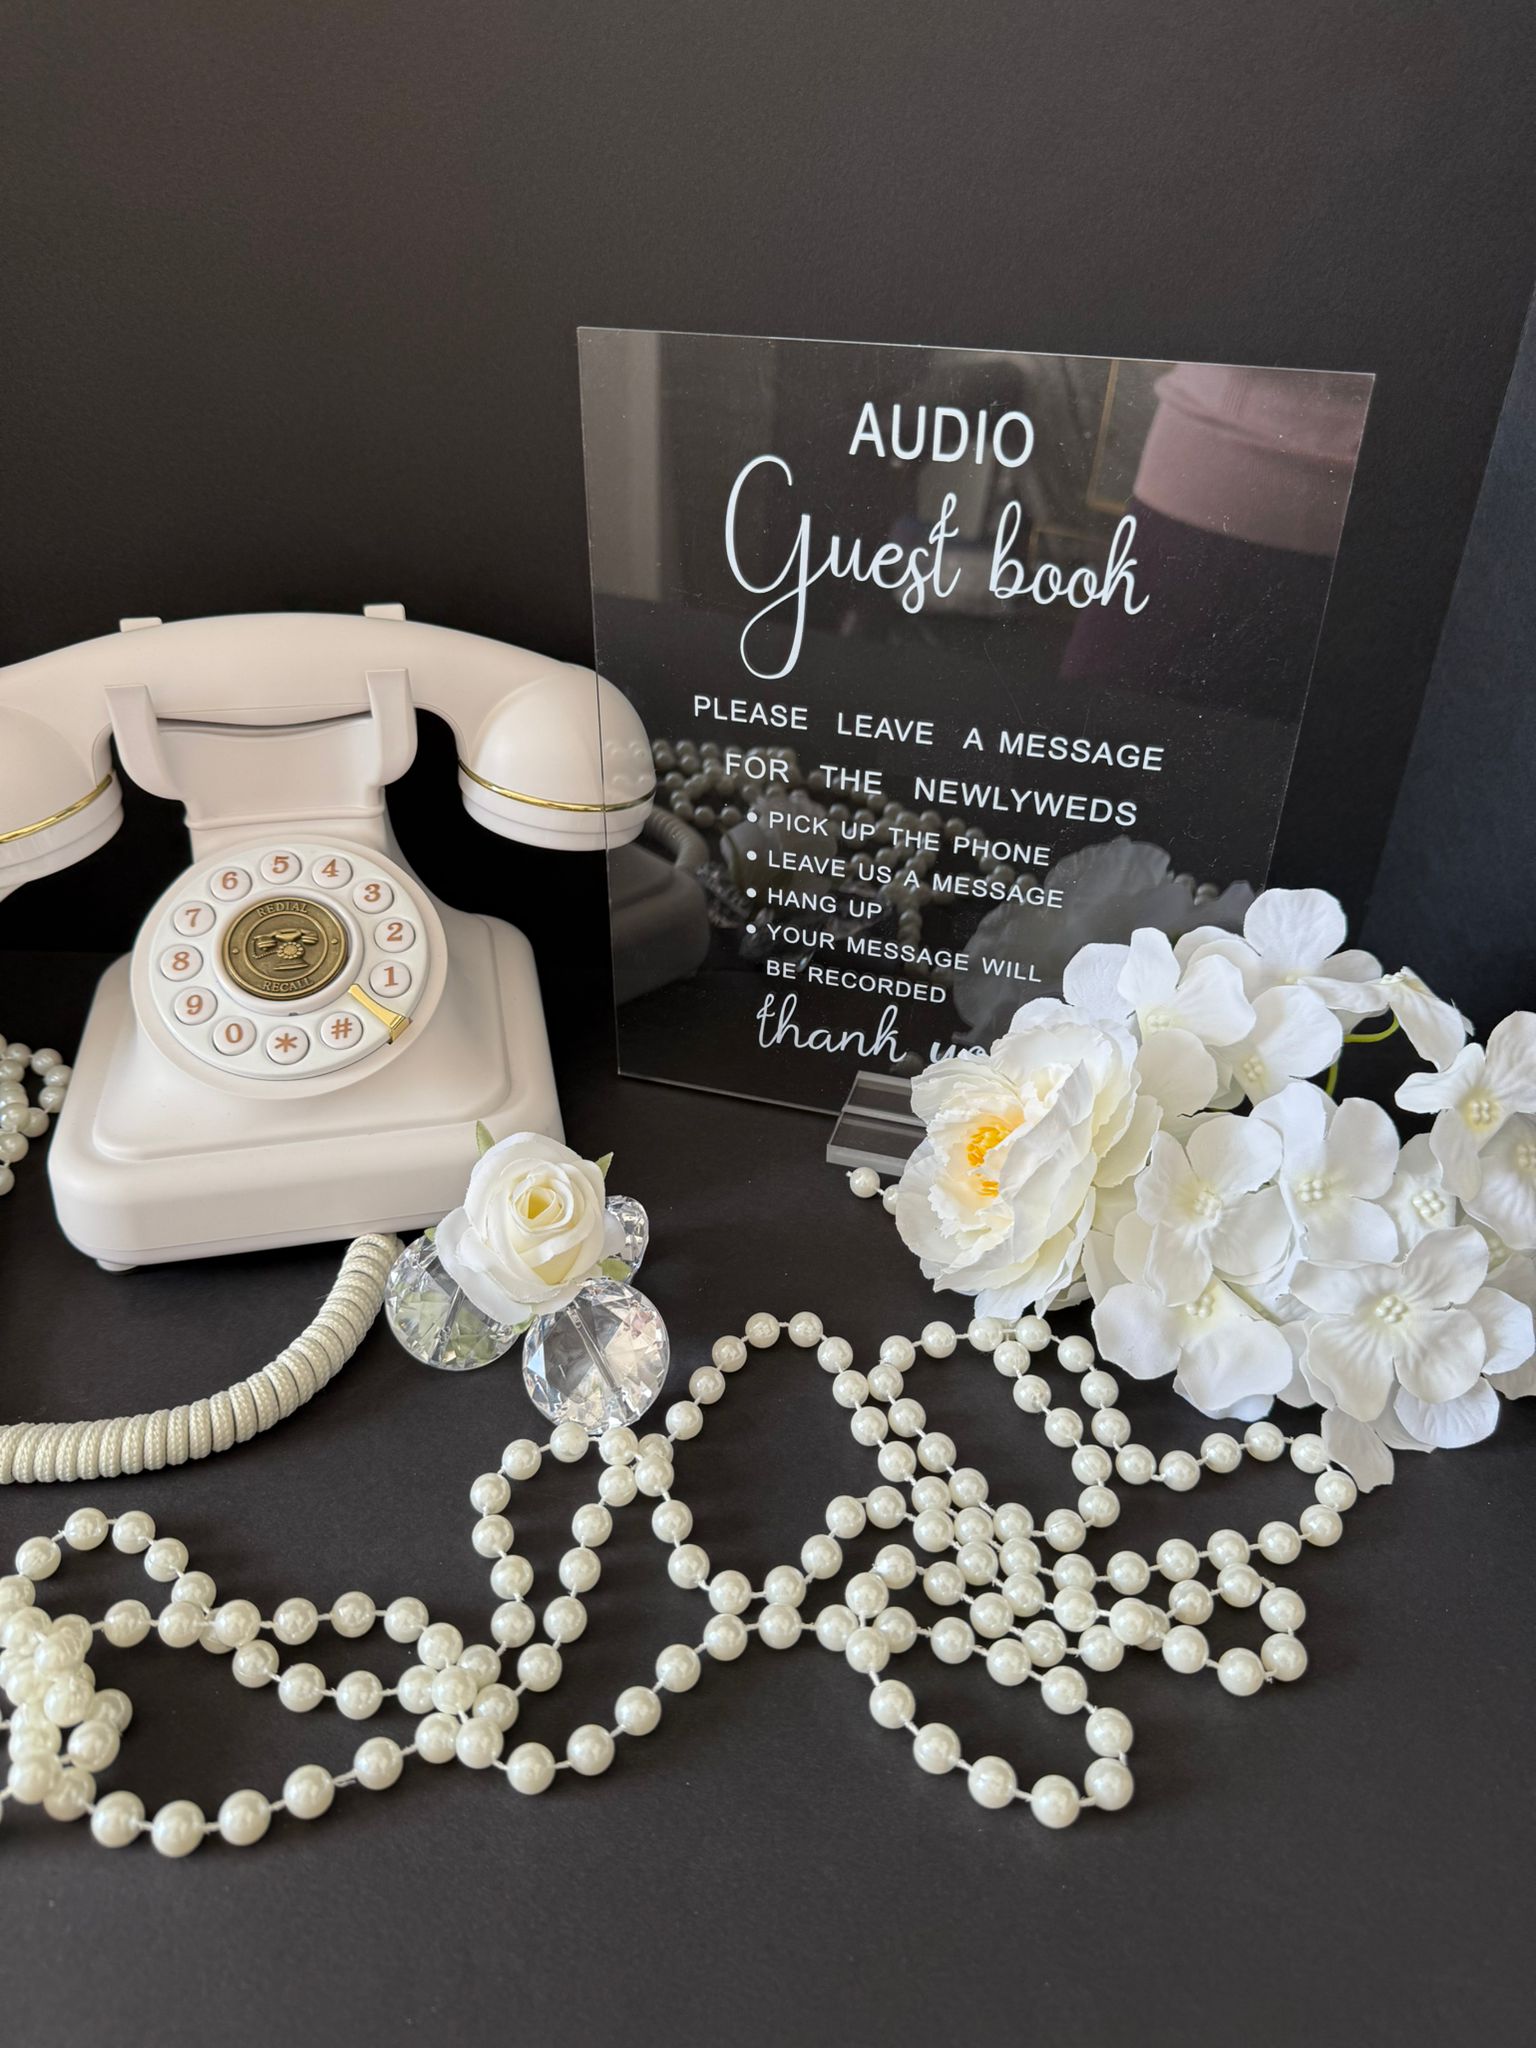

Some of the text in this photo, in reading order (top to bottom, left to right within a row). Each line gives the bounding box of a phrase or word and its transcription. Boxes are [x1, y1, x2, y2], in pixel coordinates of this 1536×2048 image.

[849, 402, 1034, 467] AUDIO
[725, 455, 1149, 680] Guest book
[693, 695, 1165, 771] PLEASE LEAVE A MESSAGE
[725, 754, 1138, 827] FOR THE NEWLYWEDS
[769, 812, 1051, 866] PICK UP THE PHONE
[272, 856, 289, 874] 5
[322, 859, 339, 878] 4
[222, 872, 238, 890] 6
[768, 850, 1065, 908] LEAVE US A MESSAGE
[364, 883, 380, 902] 3
[257, 902, 308, 917] REDIAL
[768, 888, 882, 920] HANG UP
[185, 908, 201, 928] 7
[387, 923, 403, 941] 2
[172, 951, 190, 971] 8
[767, 924, 1042, 982] YOUR MESSAGE WILL
[263, 977, 312, 991] RECALL
[383, 966, 398, 987] 1
[766, 960, 947, 1003] BE RECORDED
[186, 995, 203, 1015] 9
[225, 1023, 243, 1043] 0
[756, 993, 907, 1062] thank
